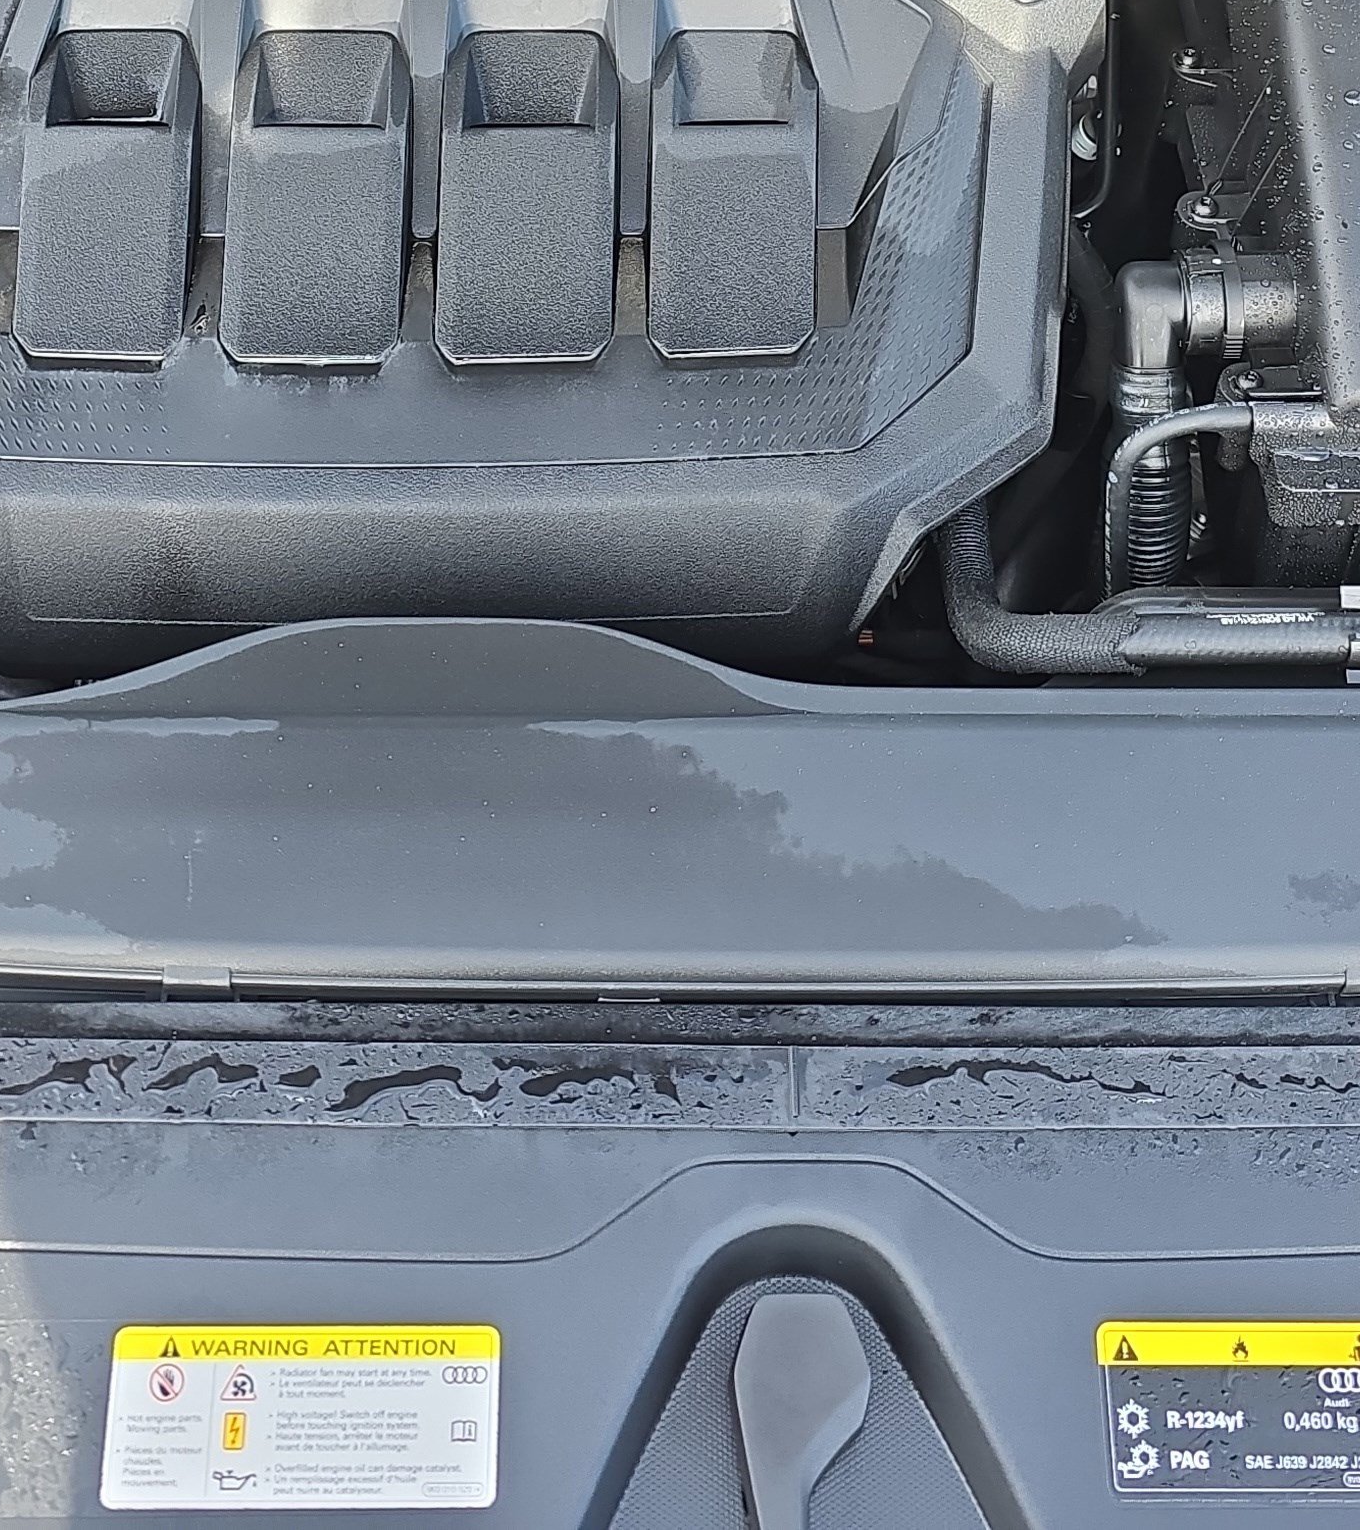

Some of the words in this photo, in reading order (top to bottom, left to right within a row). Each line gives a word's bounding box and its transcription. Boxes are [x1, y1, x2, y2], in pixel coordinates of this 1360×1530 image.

[191, 1339, 309, 1356] WARNING
[323, 1339, 456, 1356] ATTENTION
[1324, 1398, 1350, 1407] Audi
[1166, 1410, 1245, 1433] R-1234yf
[1283, 1412, 1332, 1432] 0,460
[1336, 1411, 1359, 1433] kg
[1170, 1450, 1210, 1469] PAG
[1244, 1454, 1273, 1469] SAE
[1275, 1455, 1308, 1469] J639
[1309, 1455, 1348, 1469] J2842
